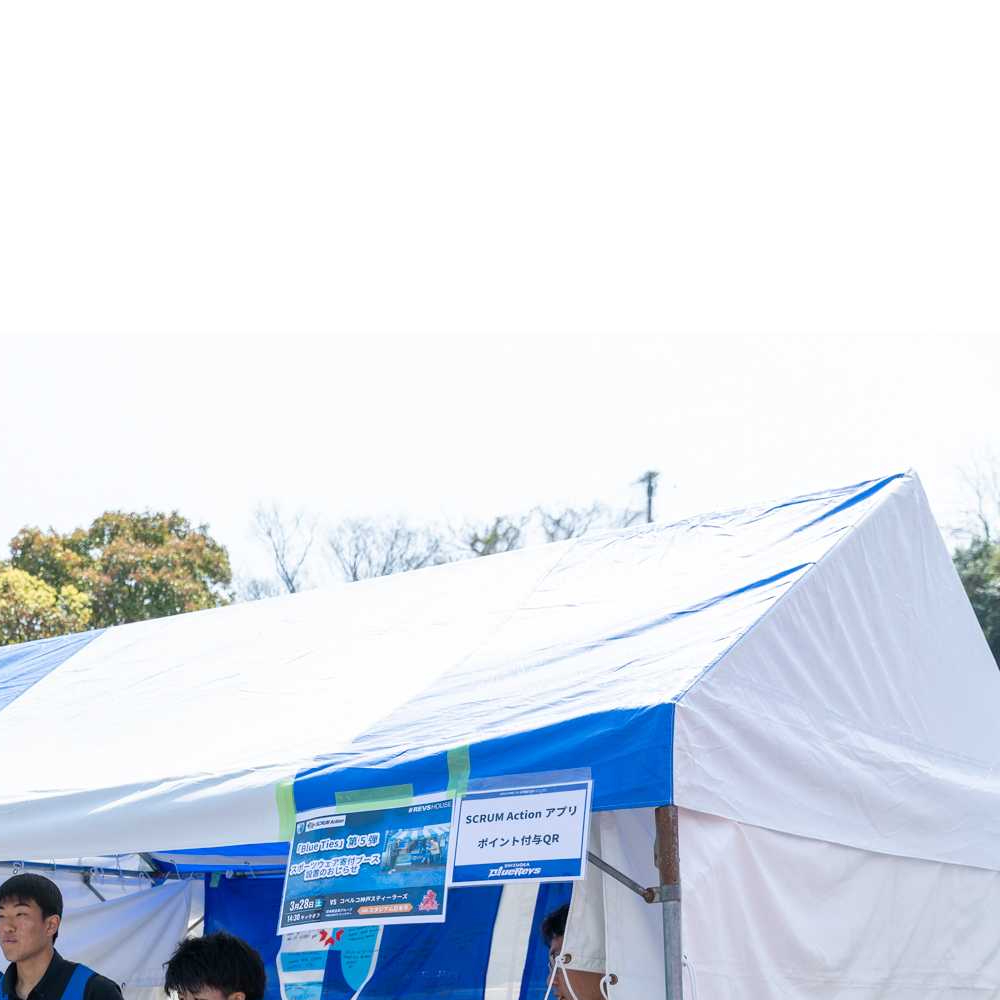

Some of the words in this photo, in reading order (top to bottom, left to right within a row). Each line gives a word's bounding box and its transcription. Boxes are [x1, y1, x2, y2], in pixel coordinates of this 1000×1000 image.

[466, 812, 505, 824] SCRUM
[506, 810, 542, 822] Action
[546, 806, 577, 818] アプリ
[477, 833, 560, 849] ポイント付与QR
